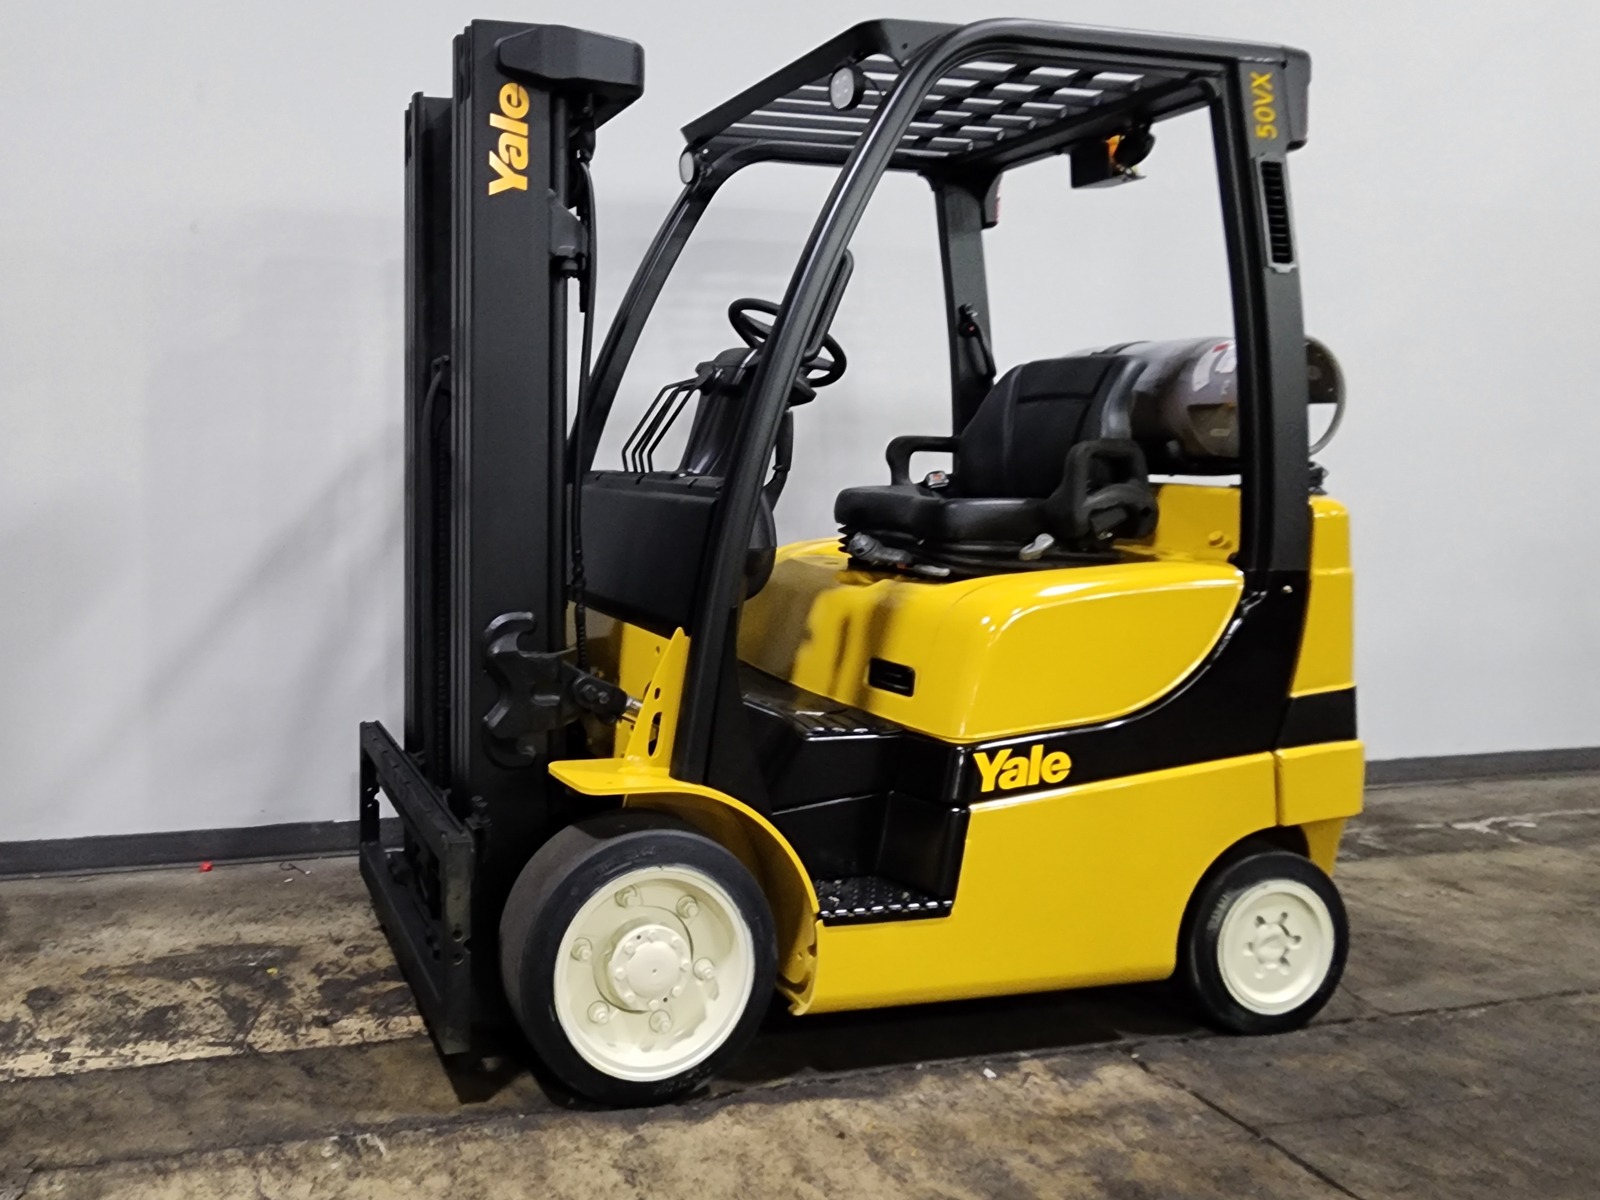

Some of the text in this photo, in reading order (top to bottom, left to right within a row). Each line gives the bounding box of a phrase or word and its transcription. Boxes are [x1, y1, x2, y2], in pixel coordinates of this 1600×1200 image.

[489, 82, 530, 196] Yale
[1250, 71, 1278, 139] 50VX
[973, 744, 1072, 792] Yale
